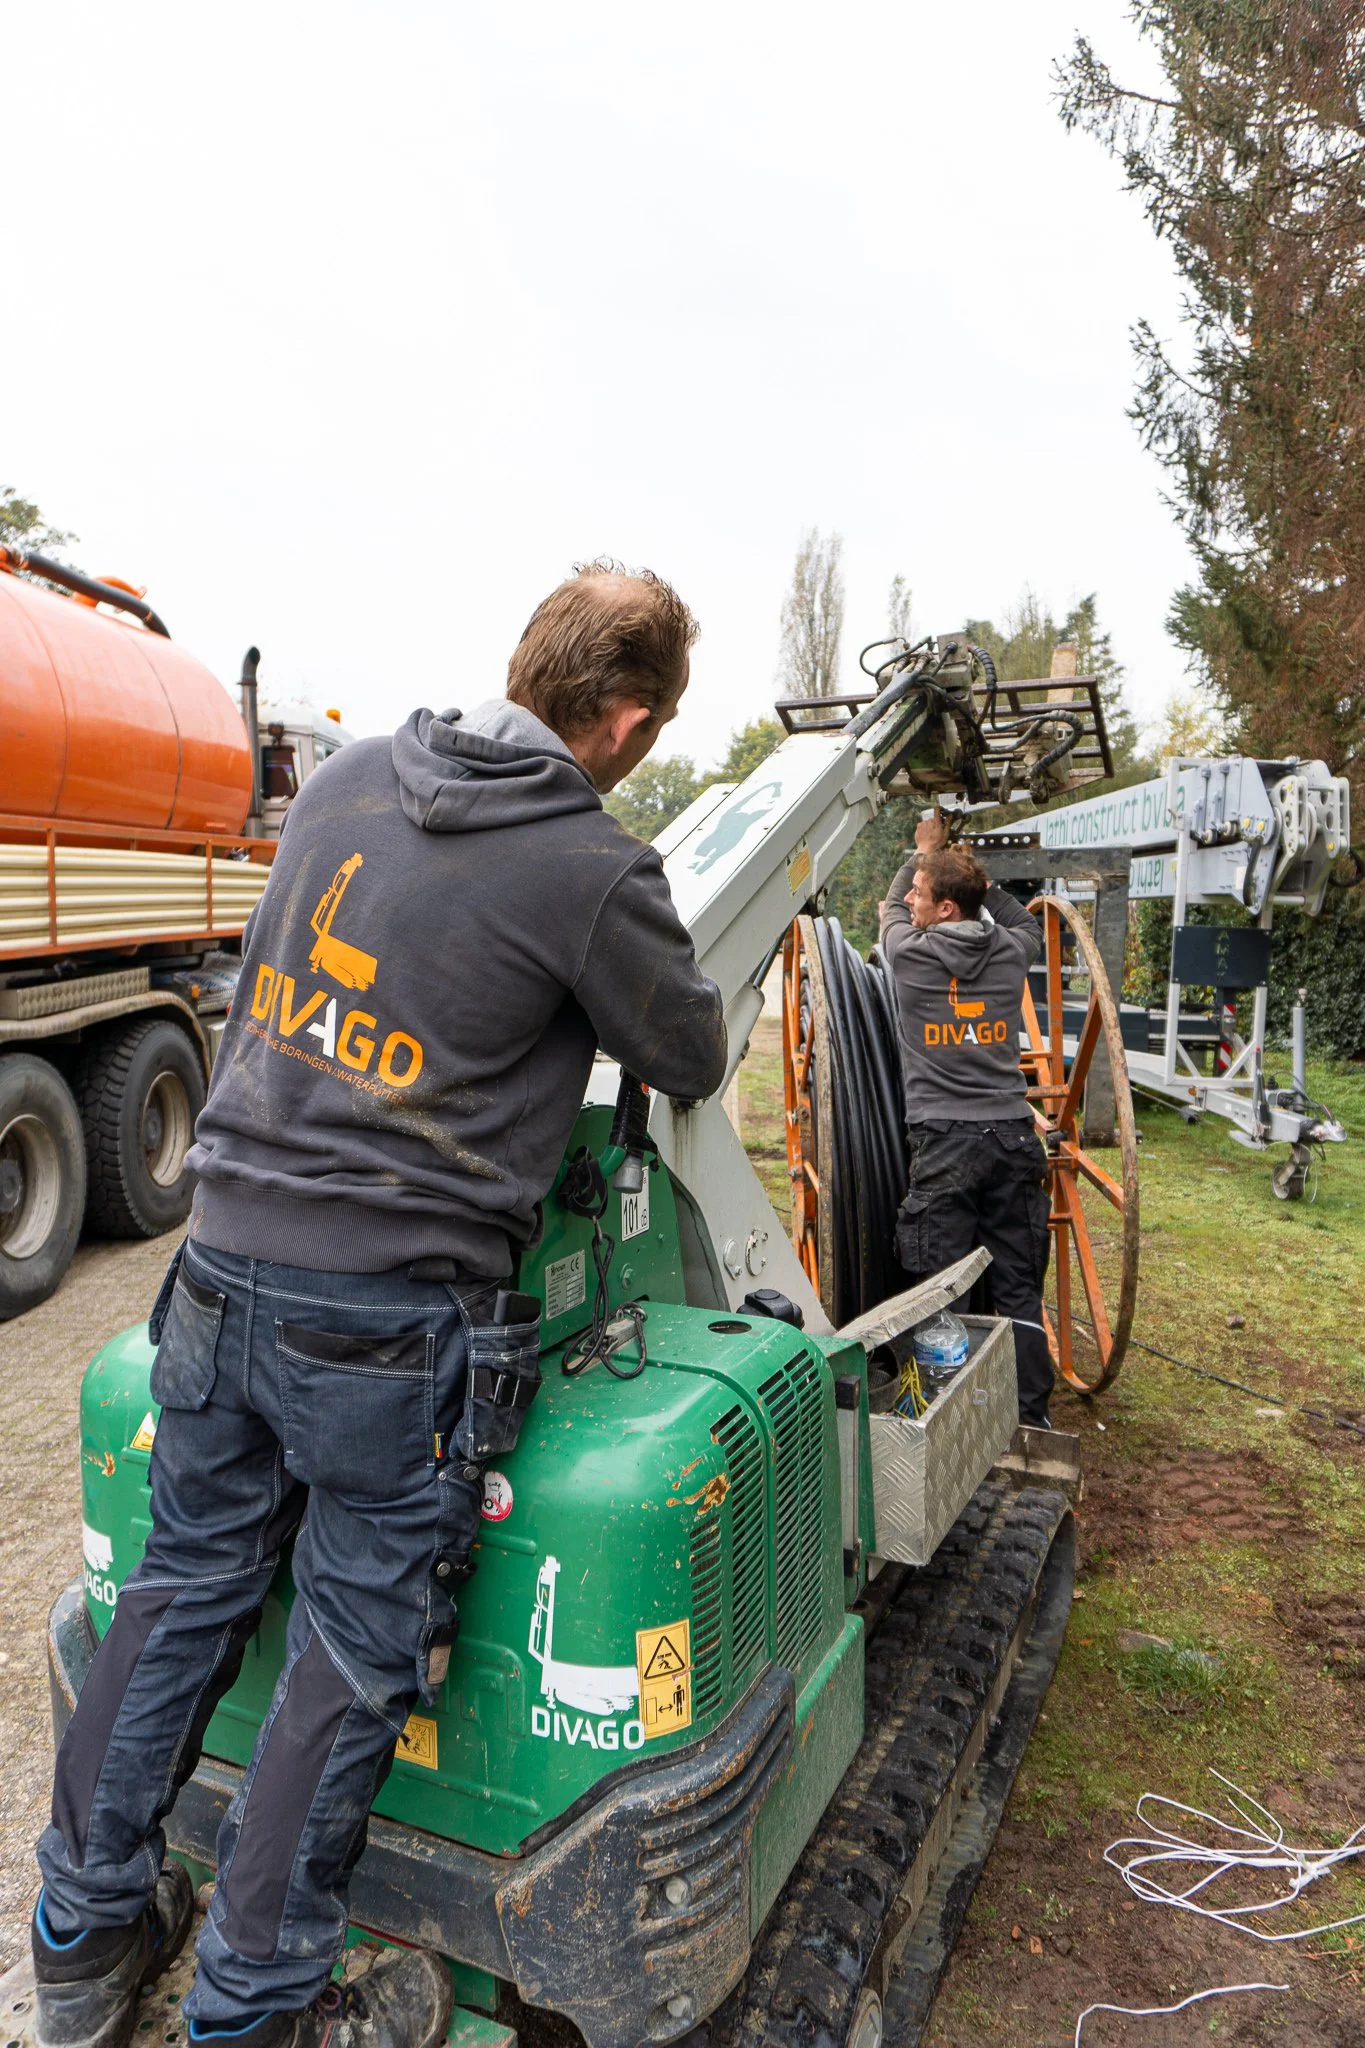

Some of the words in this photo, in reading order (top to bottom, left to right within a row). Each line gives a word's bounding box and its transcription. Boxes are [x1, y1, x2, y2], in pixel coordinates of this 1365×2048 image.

[1071, 794, 1140, 845] construct
[250, 963, 423, 1088] DIVAGO
[924, 1020, 1007, 1045] DIVAGO
[279, 1042, 333, 1074] BORINGEN
[623, 1195, 638, 1235] 101
[570, 1256, 579, 1272] CE
[531, 1705, 645, 1750] DIVAGO
